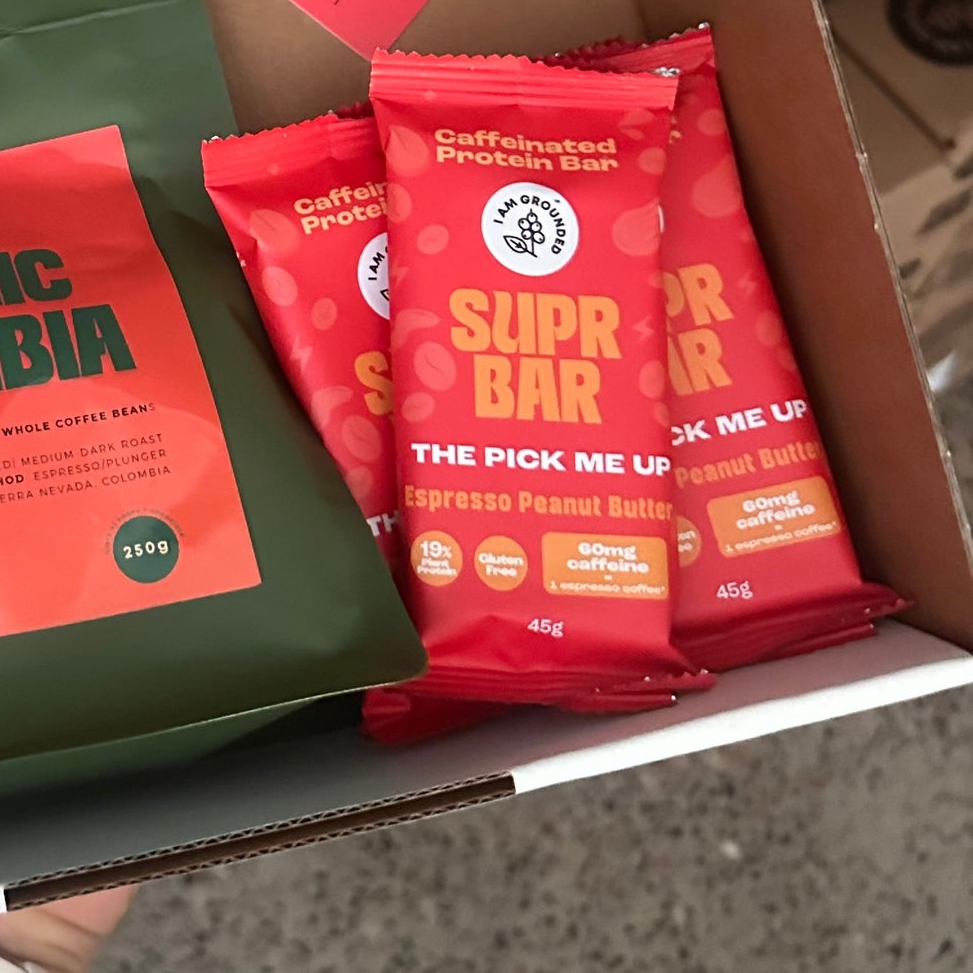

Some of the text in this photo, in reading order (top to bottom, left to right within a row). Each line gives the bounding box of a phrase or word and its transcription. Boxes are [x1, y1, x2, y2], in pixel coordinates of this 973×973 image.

[434, 128, 617, 154] Caffeinated
[436, 146, 619, 172] Protein Bar
[497, 198, 518, 218] AM
[369, 252, 385, 274] AM
[449, 288, 622, 359] SUPR
[473, 356, 602, 425] BAR
[1, 402, 156, 437] WHOLE COFFEE BEANS
[715, 407, 767, 435] ME
[770, 399, 807, 422] UP
[21, 450, 74, 467] MEDIUM
[80, 443, 116, 458] DARK
[121, 433, 164, 450] ROAST
[411, 443, 671, 476] THE PICK ME UP
[33, 448, 167, 481] ESPRESSO/PLUNGER
[674, 453, 756, 489] Peanut
[102, 465, 171, 487] COLOMBIA
[404, 484, 673, 520] Espresso Peanut Butter
[742, 490, 800, 512] 60mg
[736, 504, 816, 529] caffeine
[123, 540, 169, 559] 250g
[419, 540, 452, 559] 19%
[578, 542, 637, 561] 60mg
[735, 533, 792, 550] espresso
[478, 552, 524, 566] Gluten
[566, 558, 649, 574] caffeine
[485, 565, 517, 577] Free
[560, 581, 620, 594] espresso
[717, 580, 753, 599] 45g
[527, 618, 564, 637] 45g
